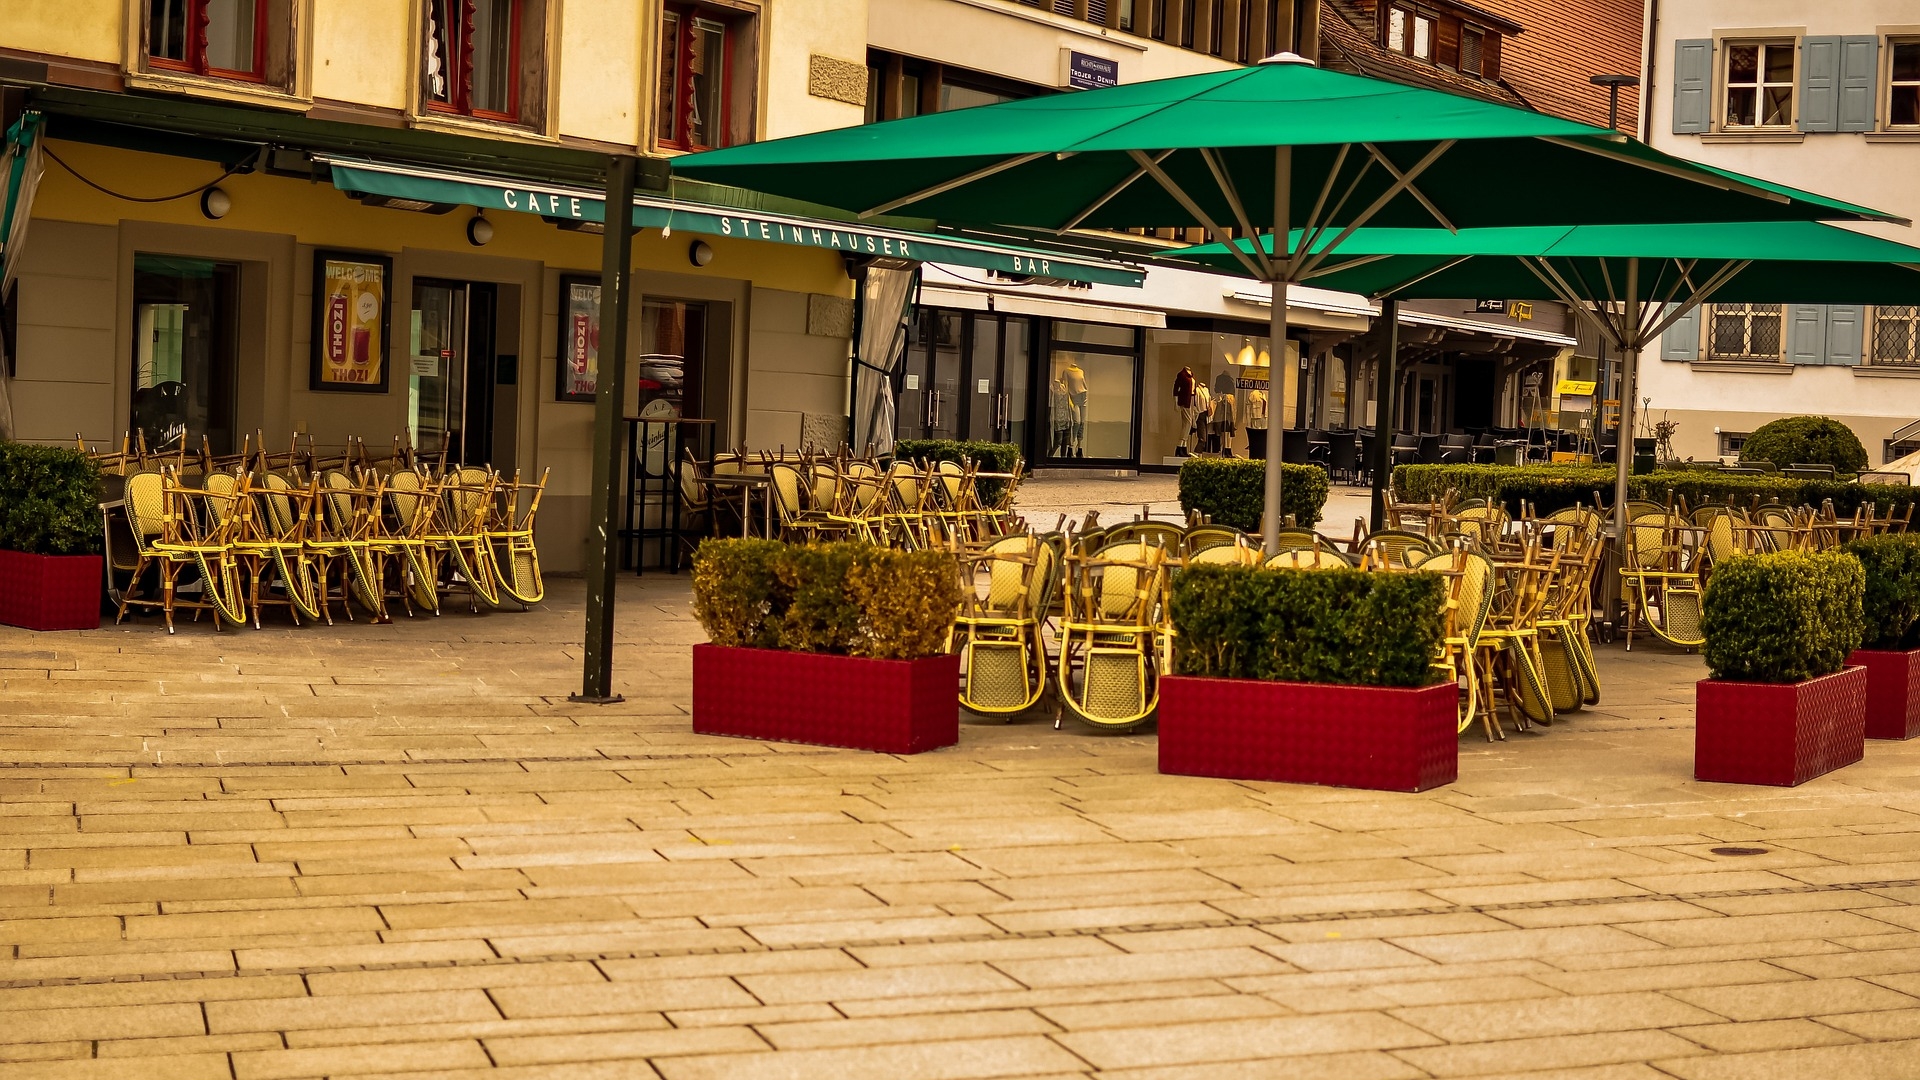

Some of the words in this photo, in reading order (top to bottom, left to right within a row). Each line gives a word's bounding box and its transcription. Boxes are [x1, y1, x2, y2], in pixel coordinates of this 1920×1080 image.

[1070, 69, 1092, 80] TROJER
[1097, 75, 1117, 86] DENIFL
[503, 189, 582, 217] CAFE
[721, 216, 910, 256] STEINHAUSER
[1014, 256, 1050, 275] BAR
[571, 288, 601, 304] WELCO
[332, 303, 344, 358] THOZI
[331, 368, 370, 382] THOZI
[574, 380, 597, 393] THO
[1236, 378, 1254, 389] VERO
[1254, 379, 1270, 390] MOD
